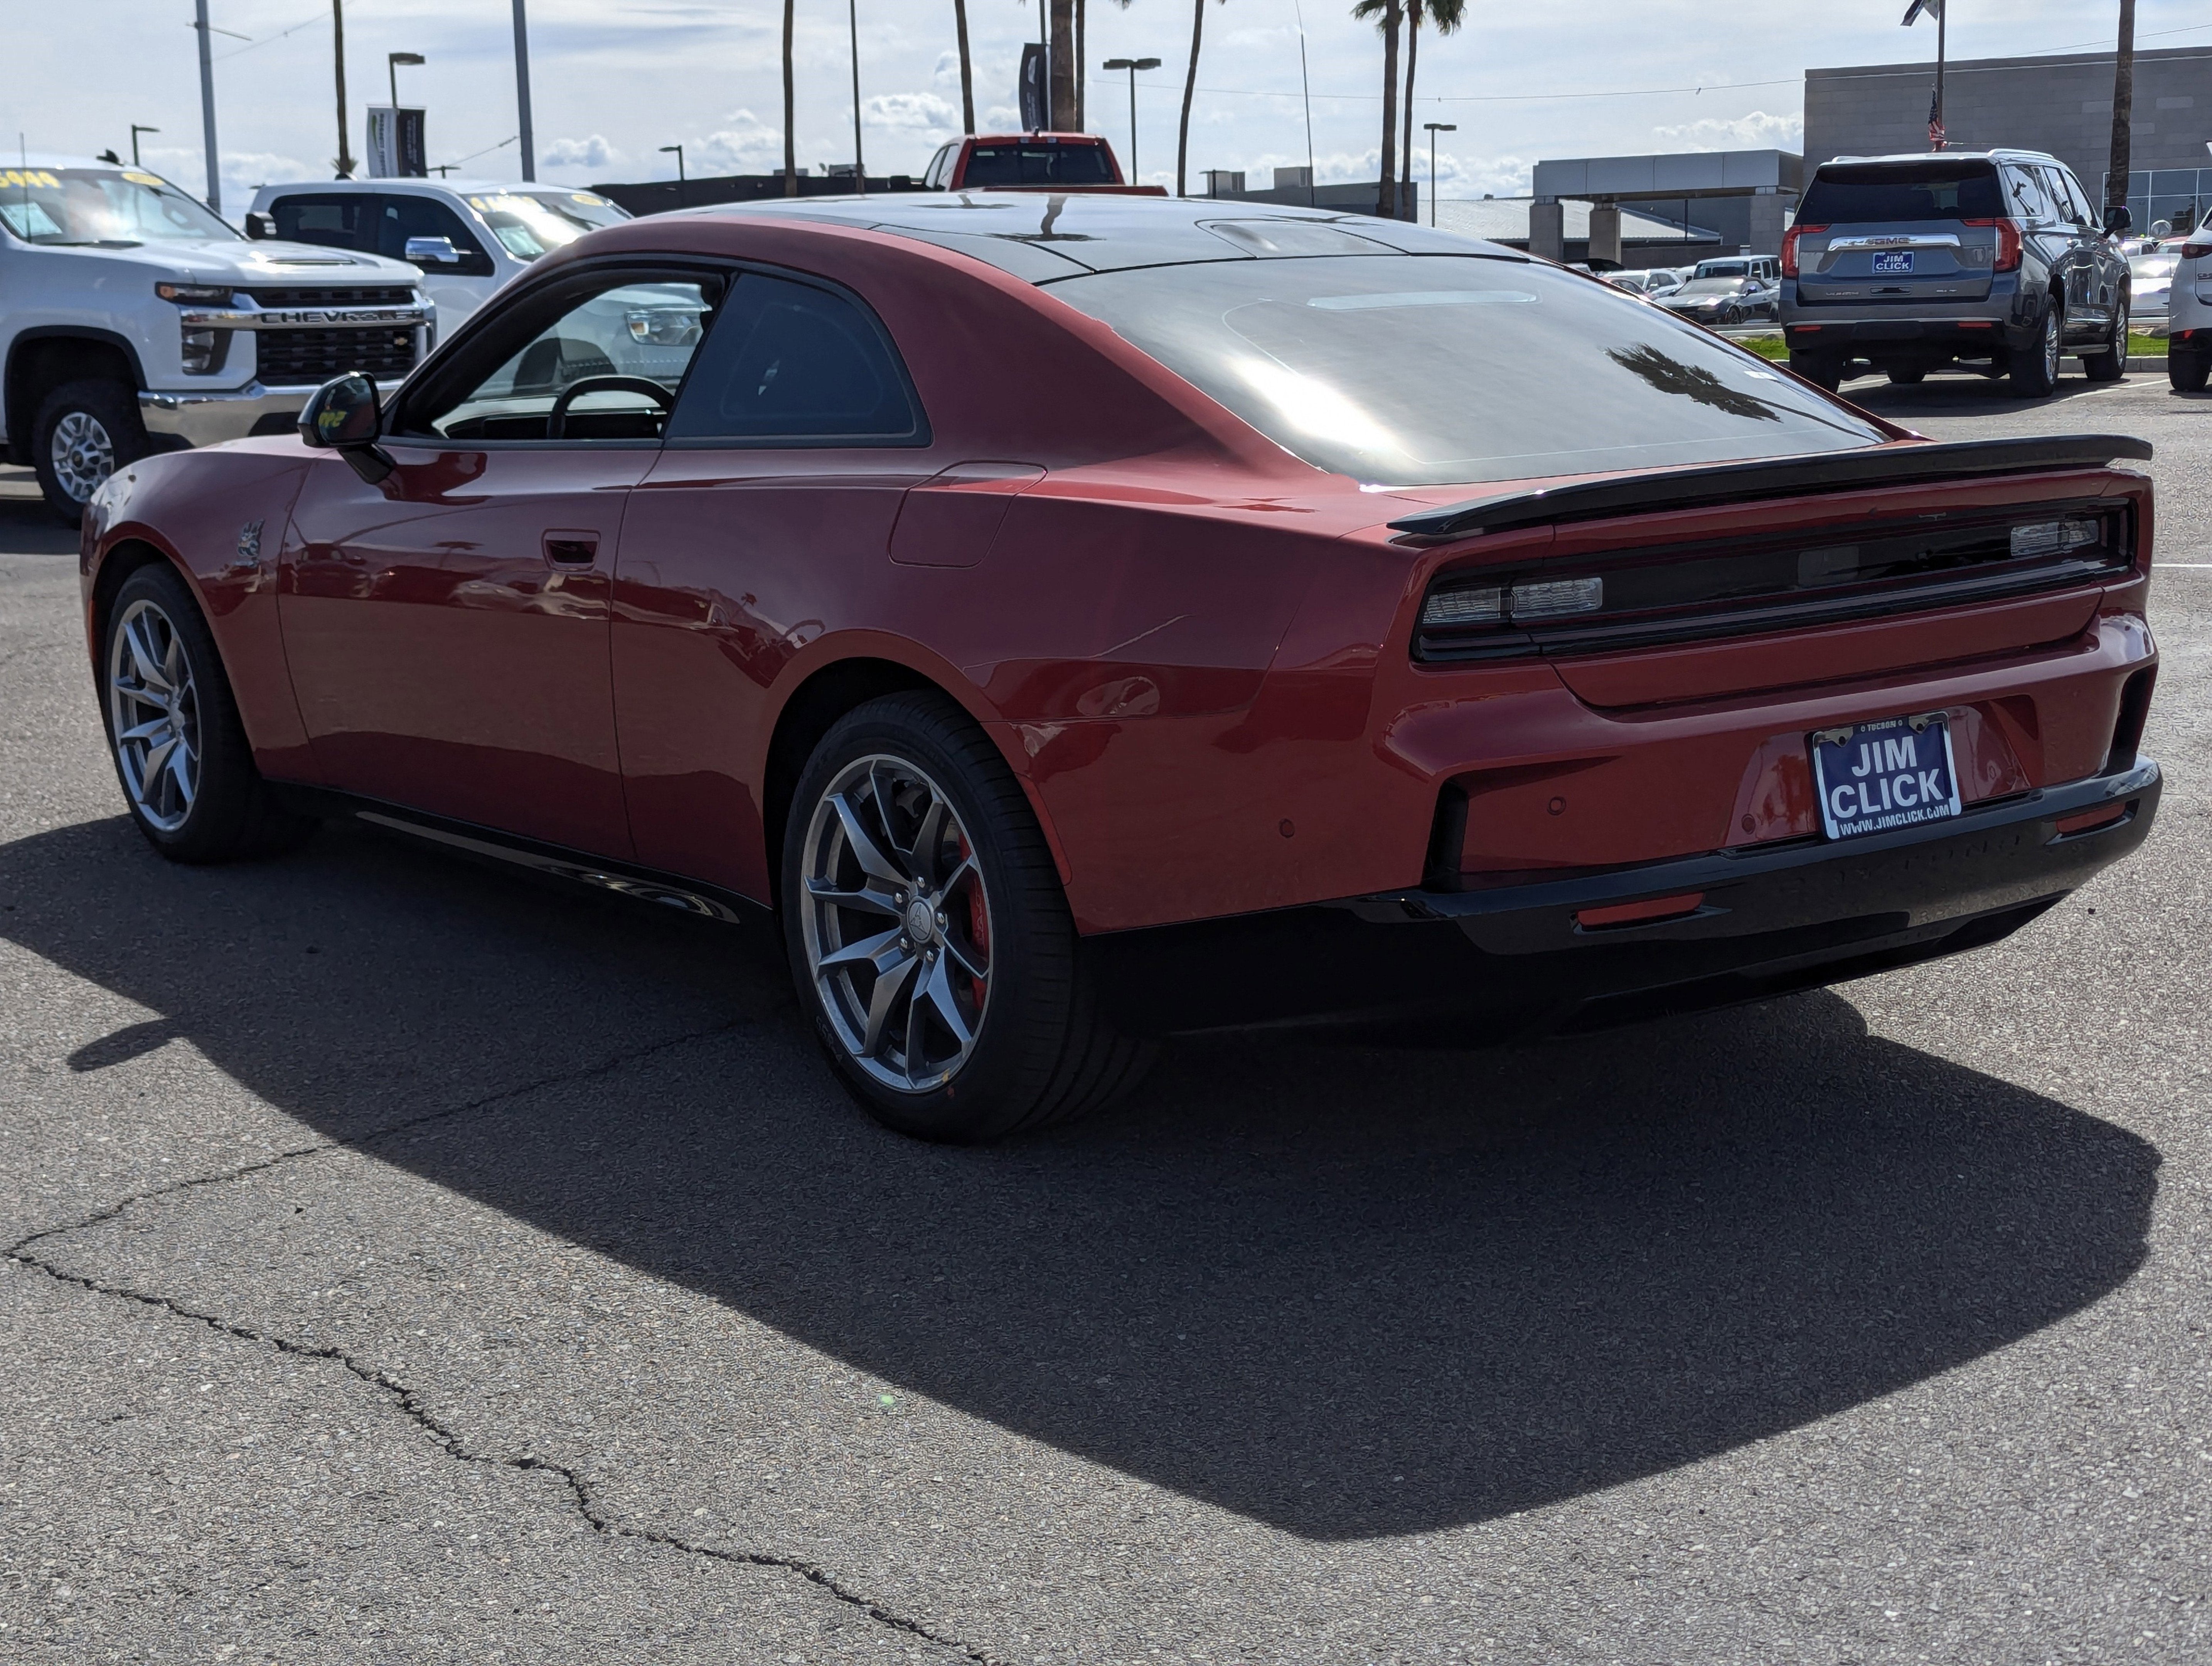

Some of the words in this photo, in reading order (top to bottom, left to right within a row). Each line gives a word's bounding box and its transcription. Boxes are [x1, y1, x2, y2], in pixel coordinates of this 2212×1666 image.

[261, 311, 423, 323] CHEVROLET
[1851, 736, 1917, 777] JIM
[1831, 768, 1944, 818] CLICK
[1840, 804, 1950, 836] WWW.JIMCLICK.COM
